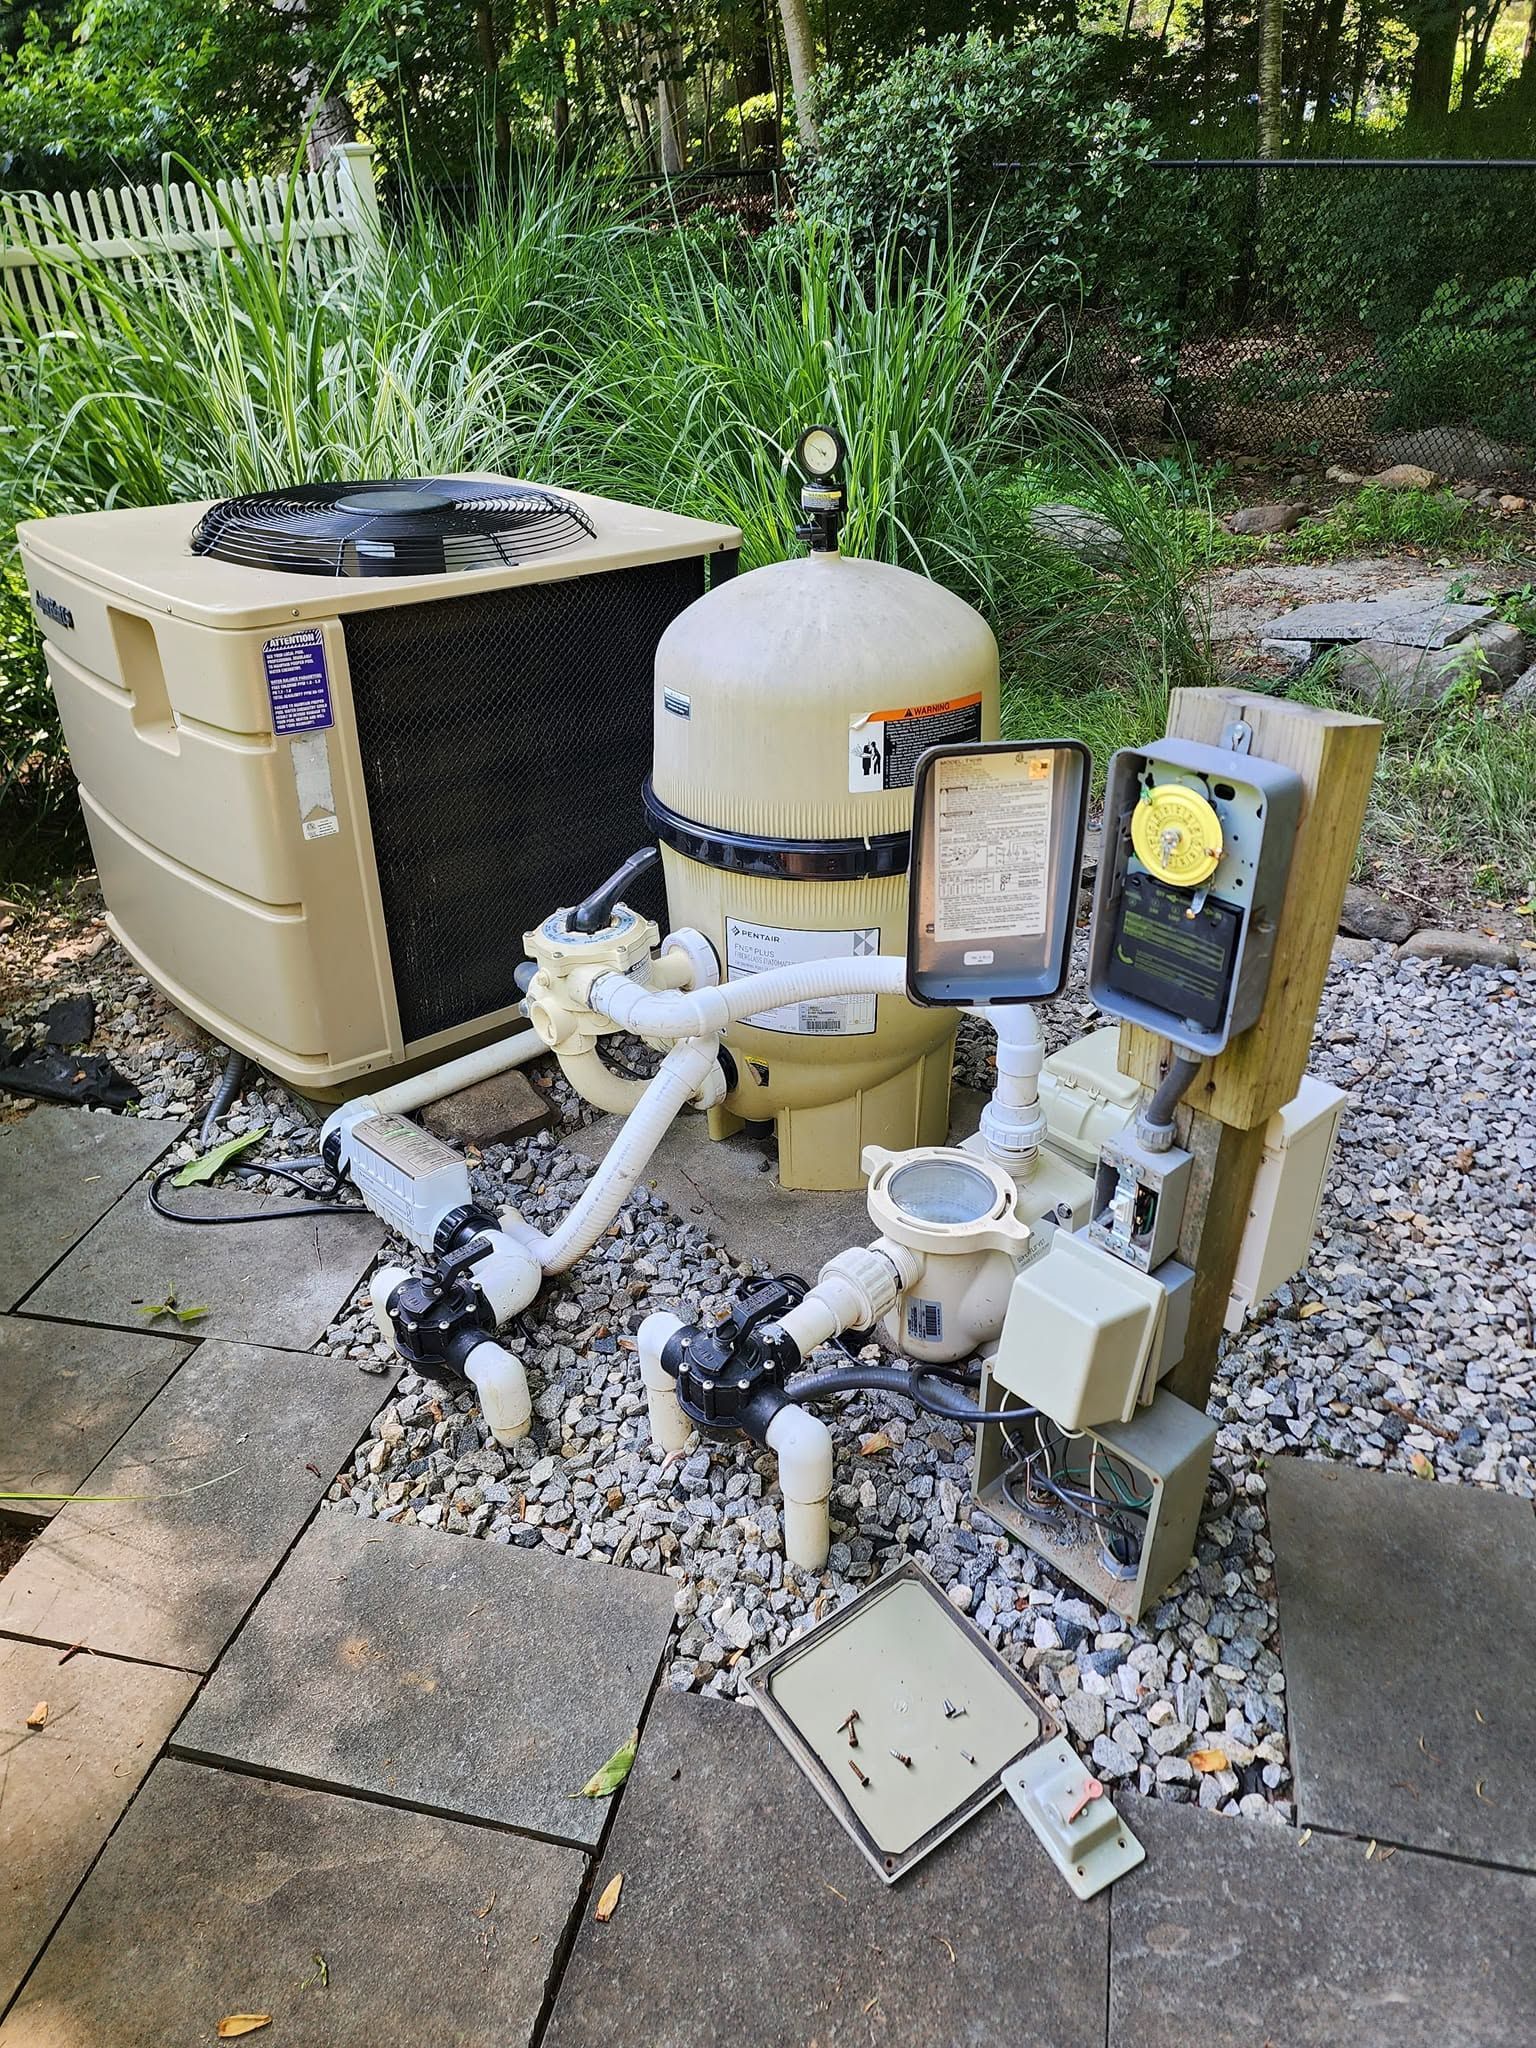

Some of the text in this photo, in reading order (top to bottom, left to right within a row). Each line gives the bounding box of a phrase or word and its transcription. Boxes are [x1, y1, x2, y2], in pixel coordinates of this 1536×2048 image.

[270, 634, 314, 647] ATTENTION
[914, 702, 950, 716] WARNING
[742, 930, 780, 943] PENTAIR
[754, 948, 775, 958] PLUS
